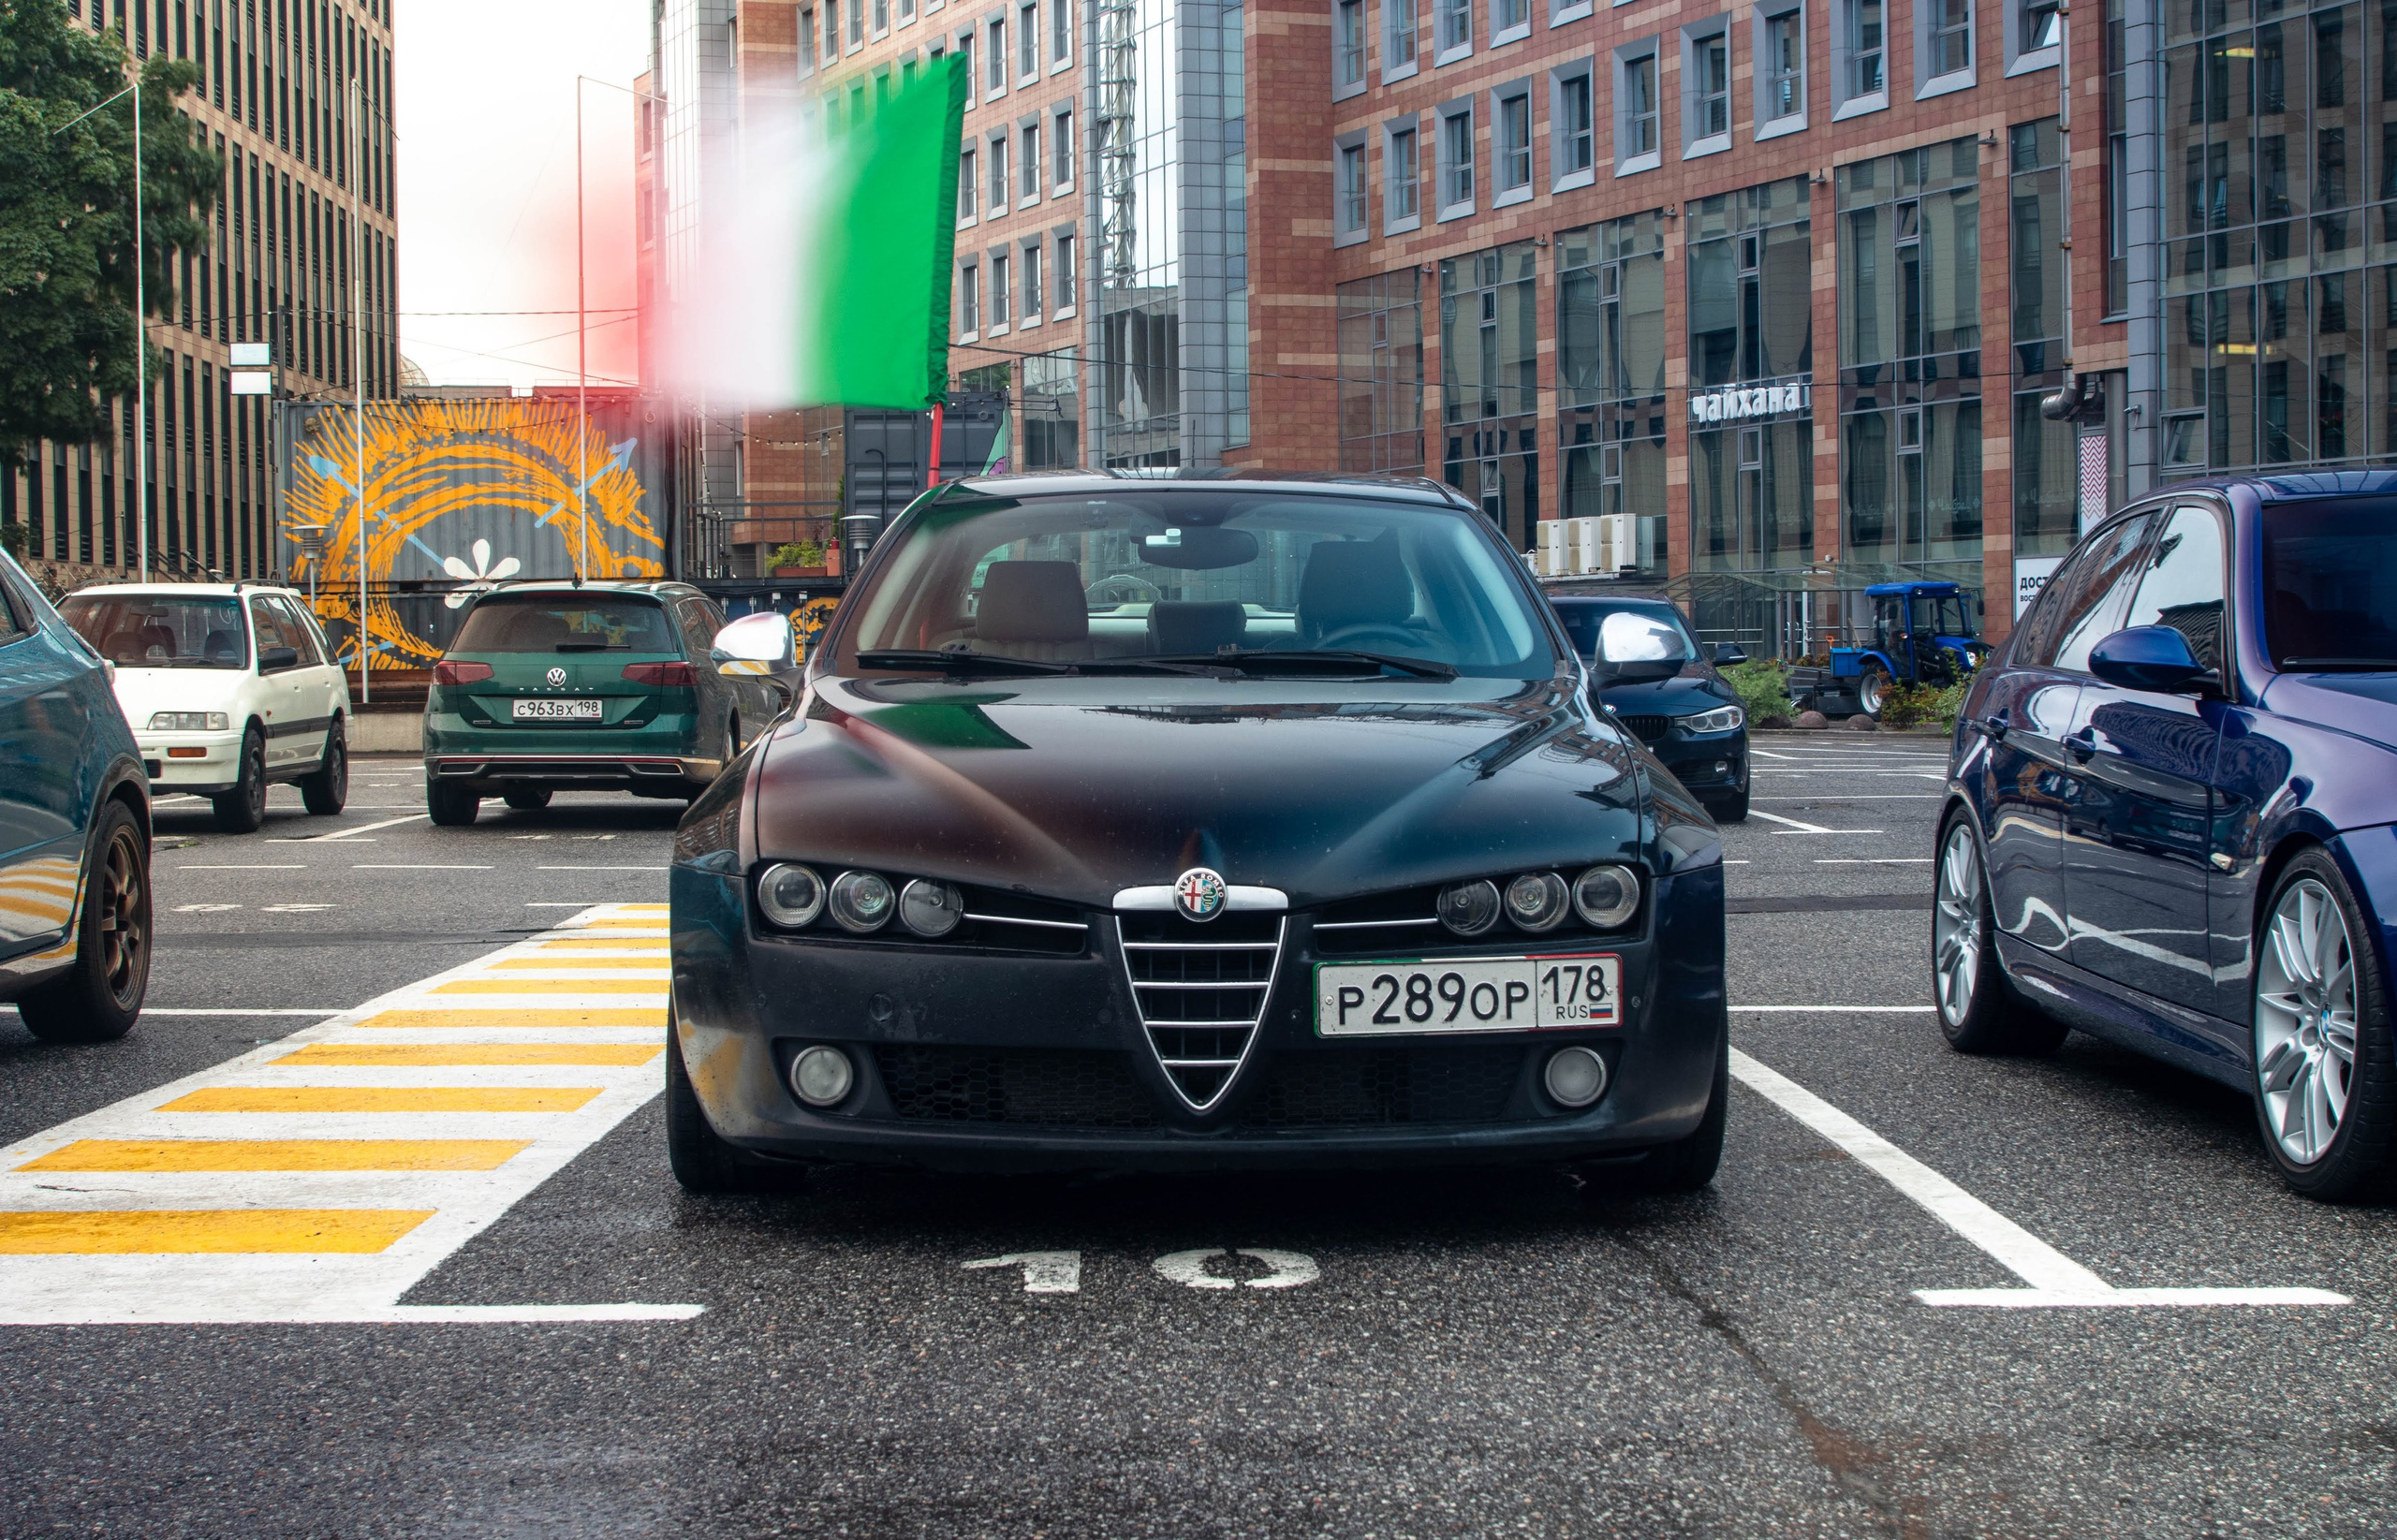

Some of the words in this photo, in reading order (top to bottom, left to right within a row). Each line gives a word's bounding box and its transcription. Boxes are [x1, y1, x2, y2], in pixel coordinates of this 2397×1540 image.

[1692, 383, 1800, 423] чайхана
[518, 702, 574, 715] С963ВХ
[578, 701, 598, 712] 198
[1178, 874, 1197, 896] ALFA
[1200, 873, 1225, 898] ROMEO
[1337, 971, 1530, 1025] Р289ОР
[1541, 964, 1605, 1005] 178
[1556, 1005, 1589, 1019] RUS
